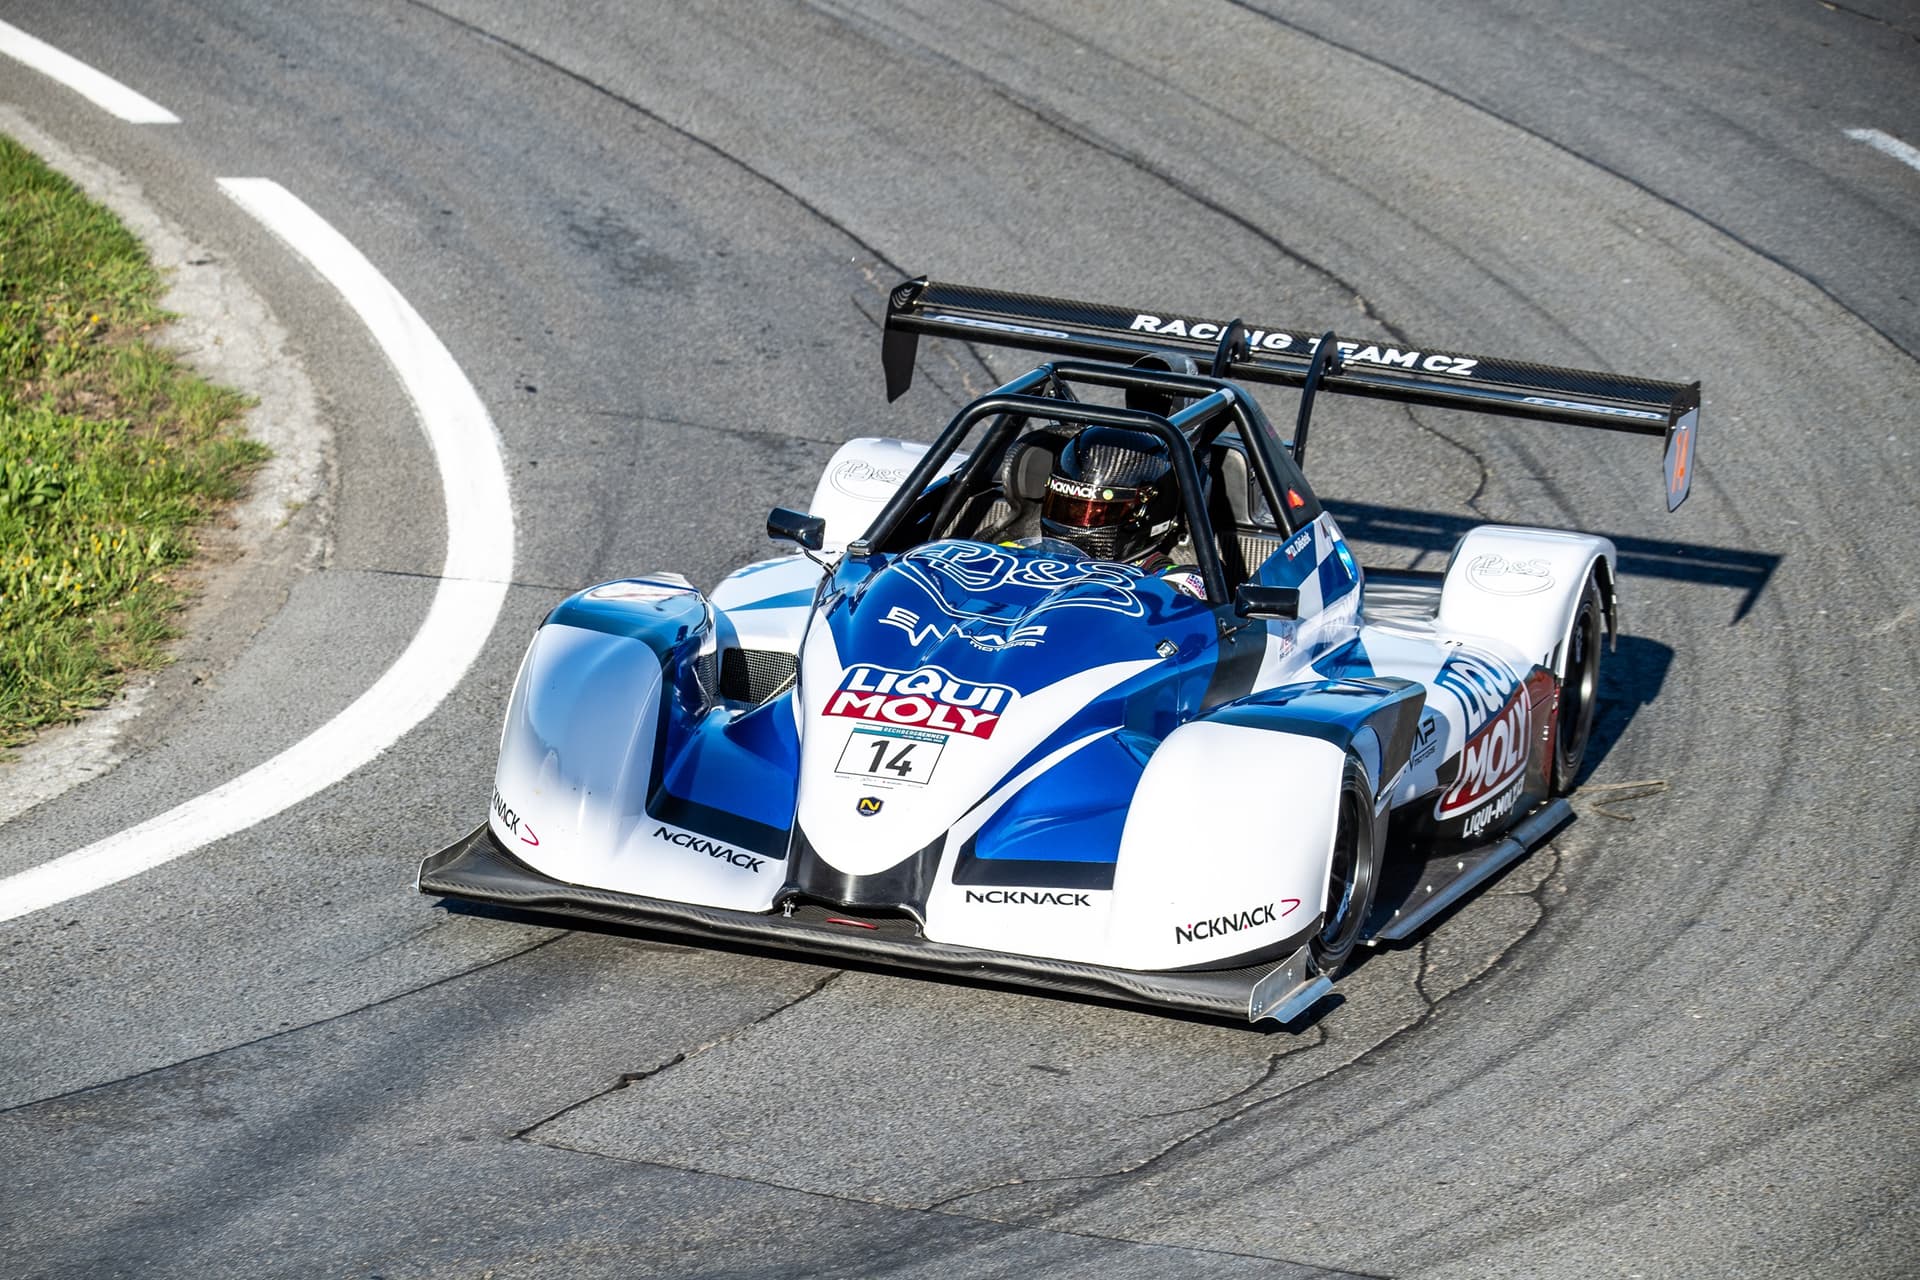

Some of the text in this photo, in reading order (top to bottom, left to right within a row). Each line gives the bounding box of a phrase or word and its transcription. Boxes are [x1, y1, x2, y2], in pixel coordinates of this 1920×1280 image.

[1307, 337, 1421, 368] TEAM
[1423, 356, 1478, 376] CZ
[830, 691, 1001, 734] MOLY
[846, 668, 1005, 713] LIQUI
[1442, 655, 1518, 736] LIQUI
[868, 740, 918, 777] 14
[1446, 690, 1527, 805] MOLY
